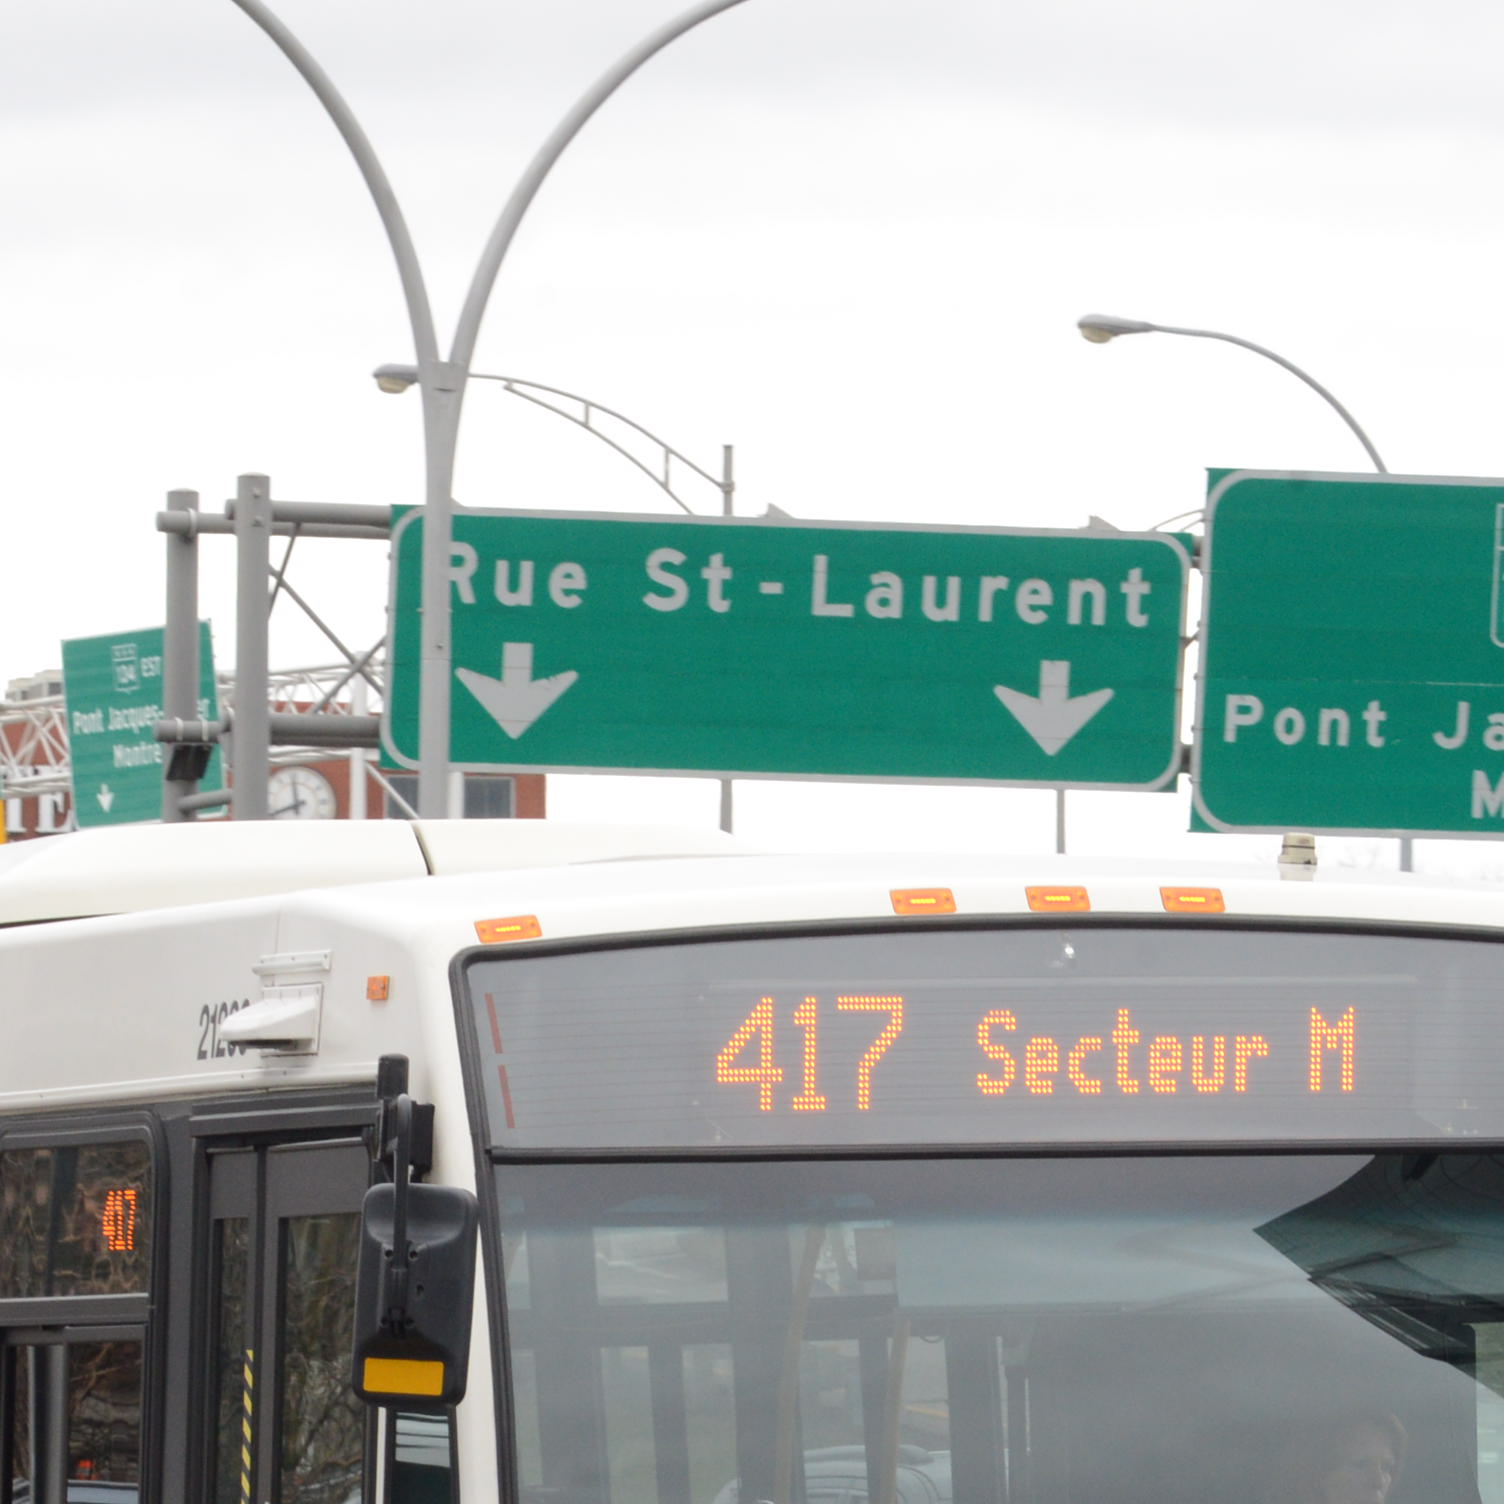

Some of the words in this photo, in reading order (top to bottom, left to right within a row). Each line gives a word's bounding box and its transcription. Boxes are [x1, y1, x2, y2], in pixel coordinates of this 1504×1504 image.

[448, 540, 587, 609] Rue
[643, 547, 1152, 627] St-Laurent
[140, 656, 161, 678] EST
[1223, 694, 1387, 748] Pont
[716, 995, 904, 1111] 417
[977, 1009, 1269, 1095] Secteur
[1309, 1006, 1355, 1092] M
[102, 1189, 137, 1251] 417
